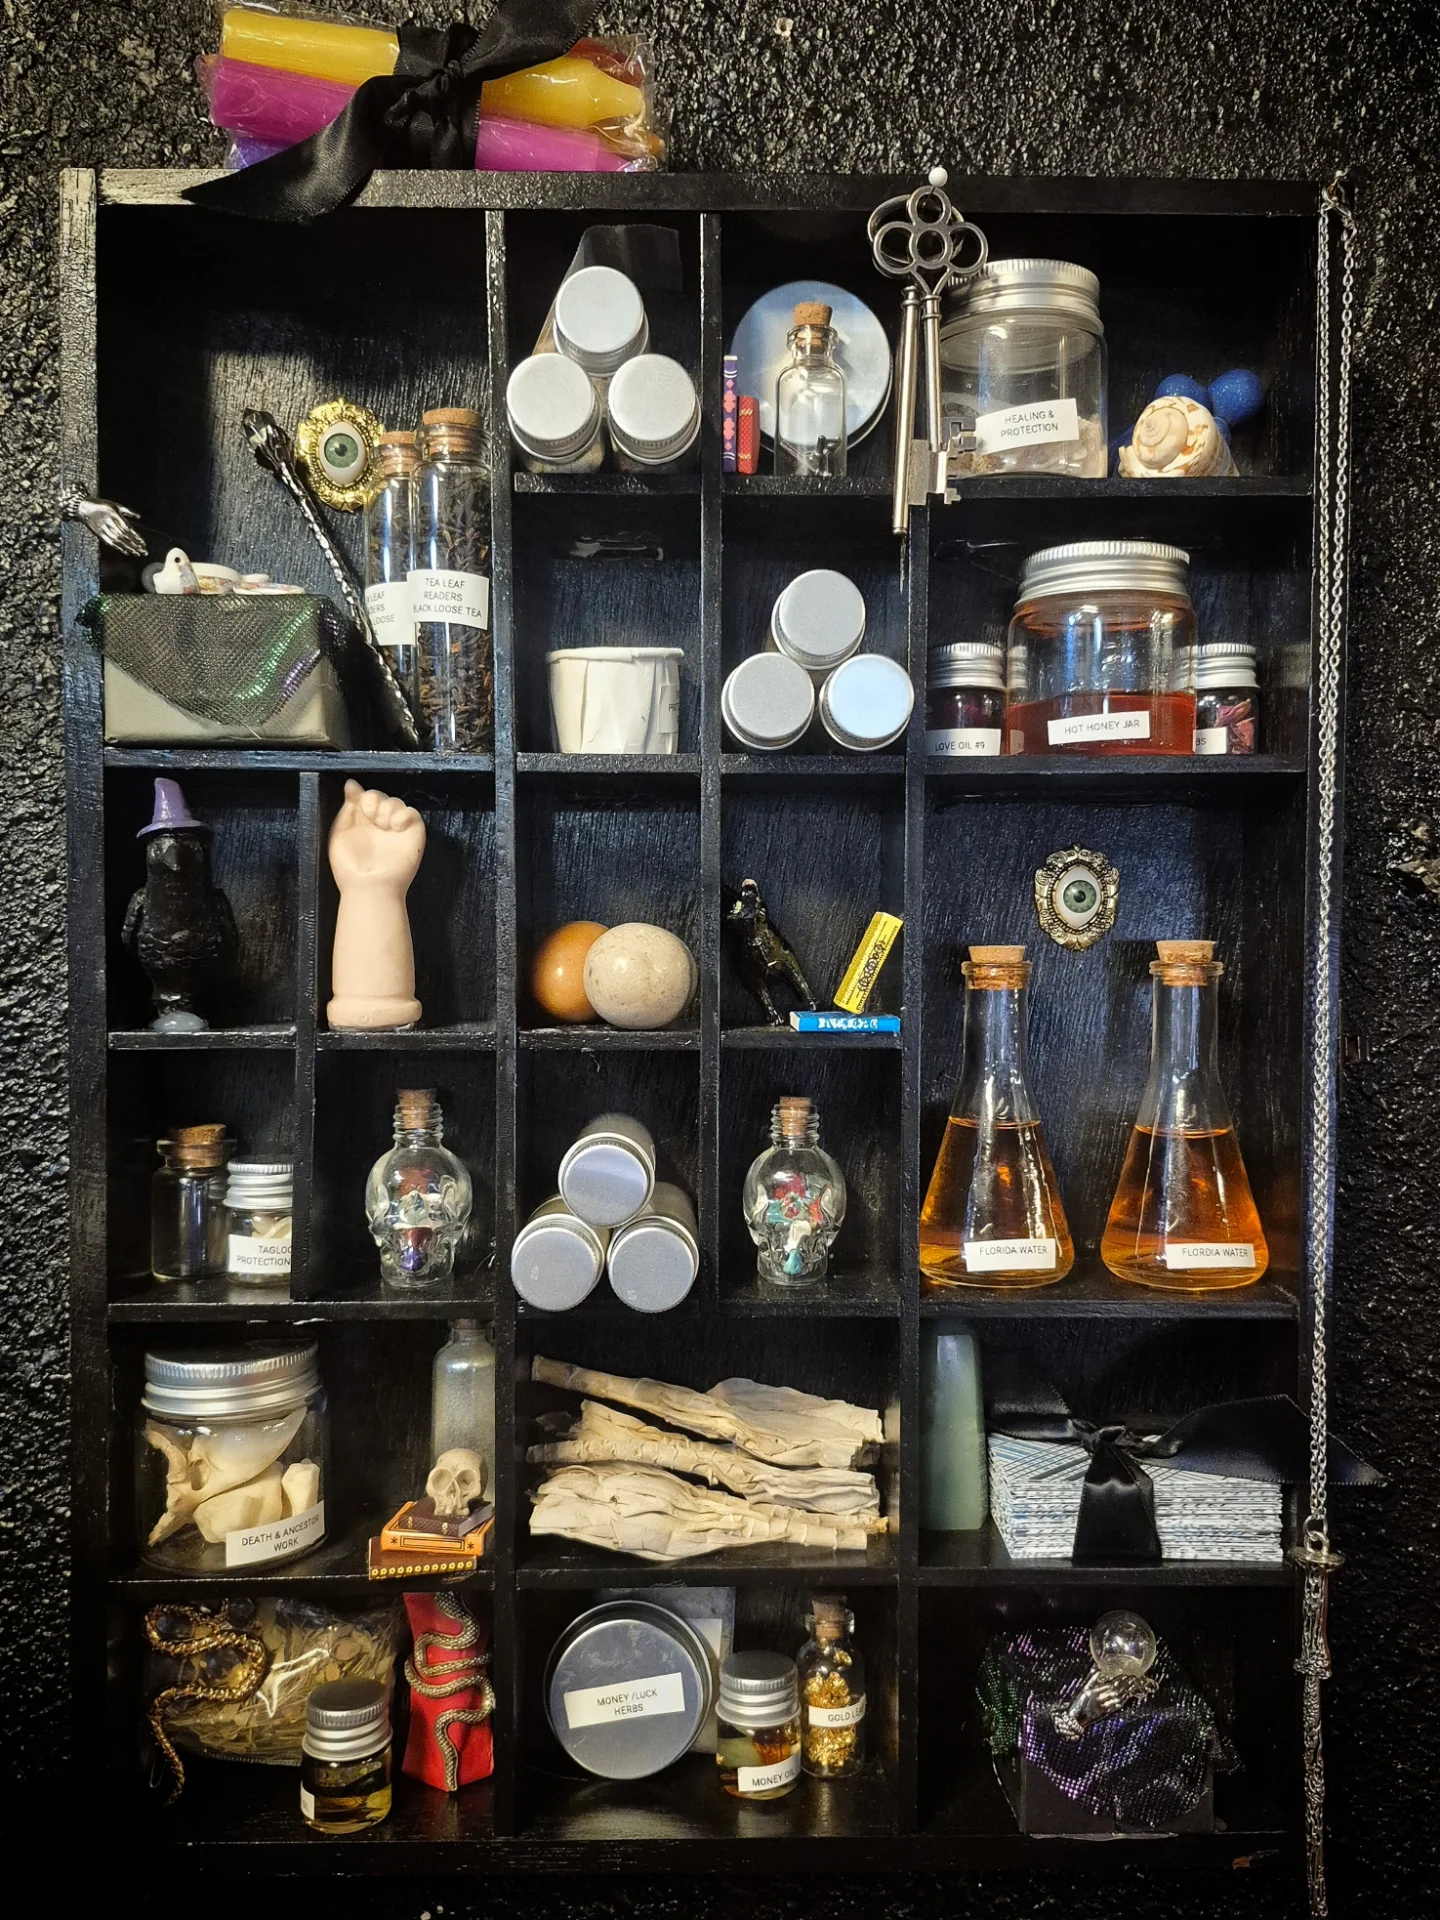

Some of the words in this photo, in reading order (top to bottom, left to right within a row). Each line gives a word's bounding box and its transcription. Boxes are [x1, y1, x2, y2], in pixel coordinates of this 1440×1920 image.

[1005, 411, 1046, 424] HEALING
[1048, 410, 1054, 418] &
[1000, 423, 1059, 437] PROTECTION
[425, 578, 440, 587] TEA
[443, 579, 466, 588] LEAF
[423, 590, 463, 602] READERS
[434, 604, 463, 615] LOOSE
[466, 607, 482, 618] TEA
[373, 614, 395, 625] LOOSE
[1064, 724, 1084, 735] HOT
[1086, 721, 1120, 731] HONEY
[1122, 719, 1140, 729] JAR
[934, 741, 956, 751] LOVE
[958, 741, 972, 750] OIL
[975, 741, 985, 750] #9
[258, 1245, 292, 1254] TAGLOC
[979, 1246, 1018, 1255] FLORIDA
[1019, 1245, 1048, 1254] WATER
[1181, 1247, 1221, 1257] FLORDIA
[1222, 1248, 1249, 1257] WATER
[237, 1255, 291, 1266] PROTECTION
[241, 1533, 272, 1546] DEATH
[274, 1531, 281, 1539] &
[282, 1514, 320, 1537] ANCESTOR
[273, 1537, 299, 1552] WORK
[597, 1693, 630, 1706] MONEY
[614, 1703, 644, 1716] HERBS
[828, 1712, 851, 1722] GOLD
[752, 1773, 783, 1786] MONEY
